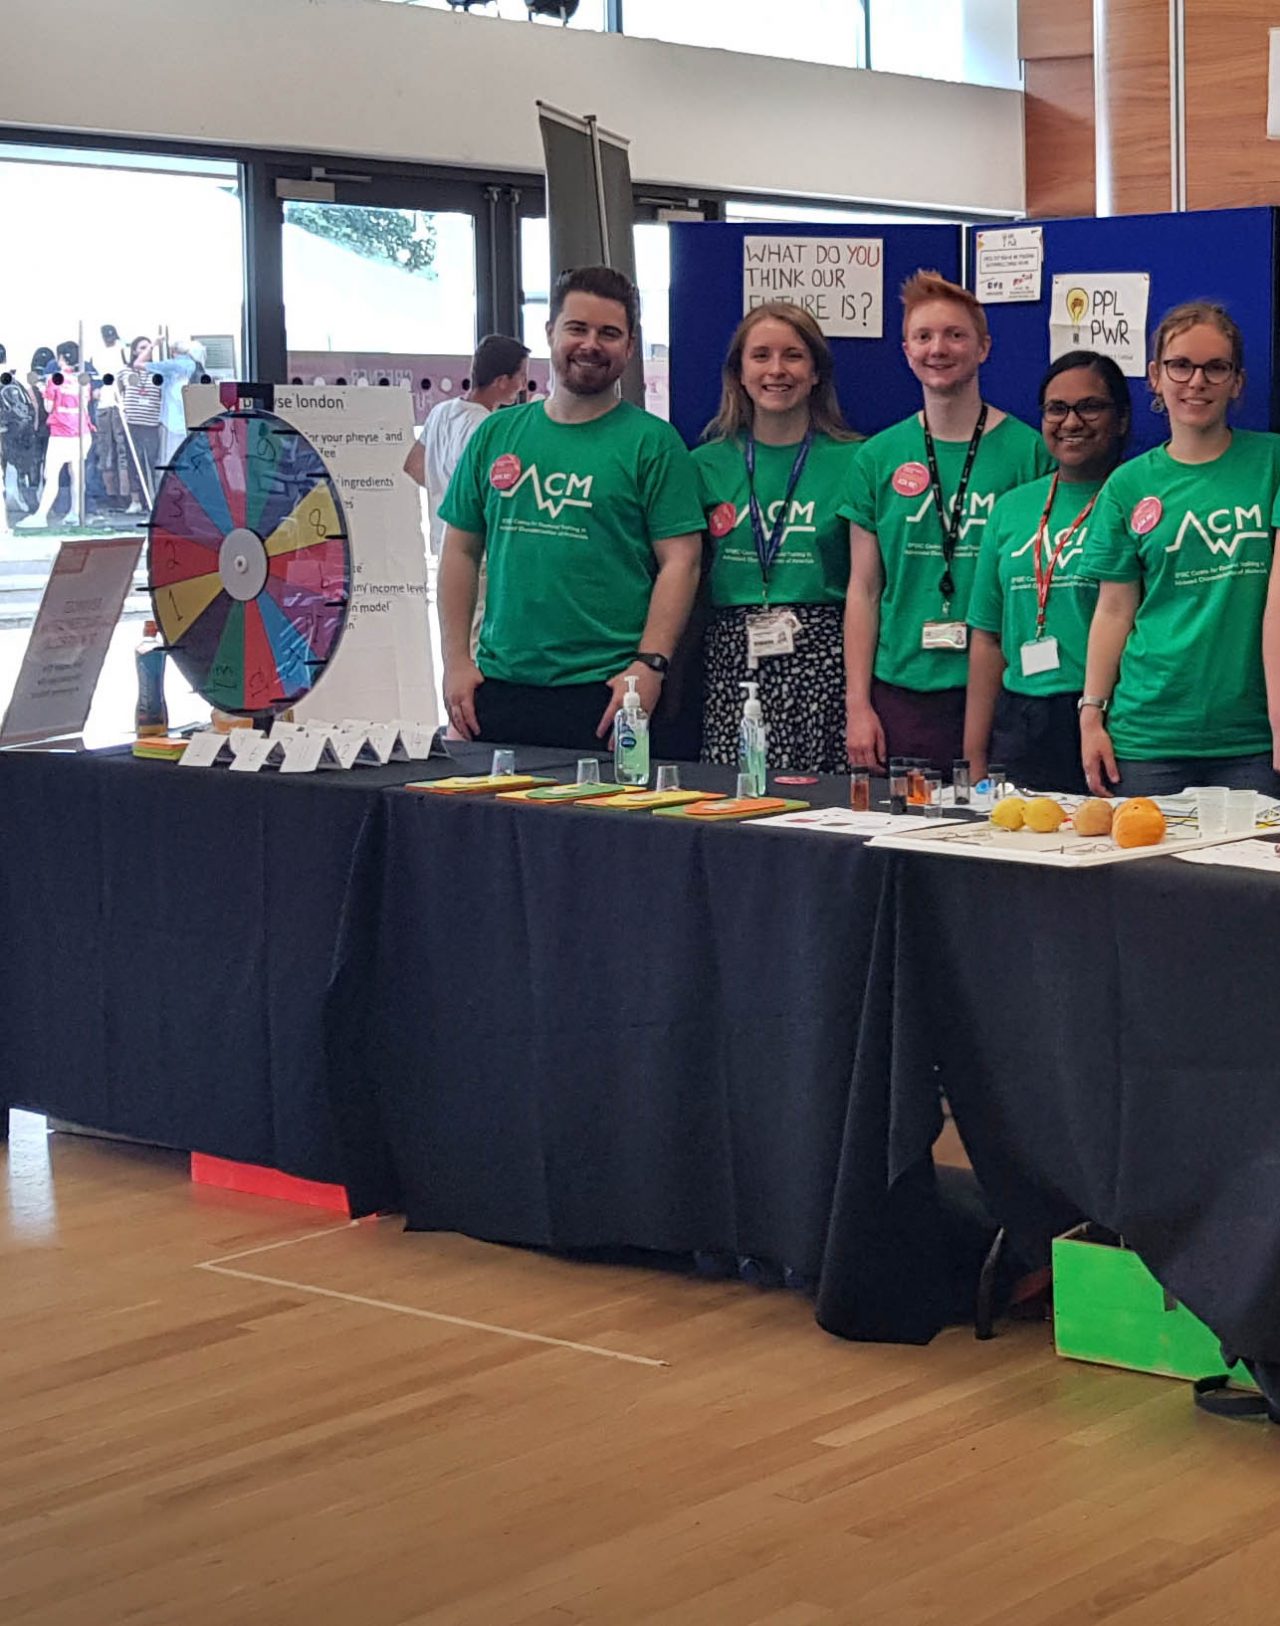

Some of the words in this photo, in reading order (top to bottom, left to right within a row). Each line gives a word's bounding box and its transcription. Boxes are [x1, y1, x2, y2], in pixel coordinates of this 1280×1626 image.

[746, 244, 807, 263] WHAT
[816, 245, 840, 264] DO
[847, 245, 880, 267] YOU
[745, 268, 805, 290] THINK
[811, 268, 845, 288] OUR
[841, 291, 873, 326] IS?
[1092, 290, 1124, 316] PPL
[1091, 319, 1130, 345] PWR
[296, 393, 345, 409] london
[321, 433, 343, 443] your
[385, 431, 403, 440] and
[341, 476, 394, 488] ingredients
[501, 463, 593, 519] ACM
[308, 508, 327, 537] 8
[1165, 504, 1268, 558] ACM
[370, 584, 404, 593] income
[169, 589, 183, 622] 1
[360, 602, 390, 613] model
